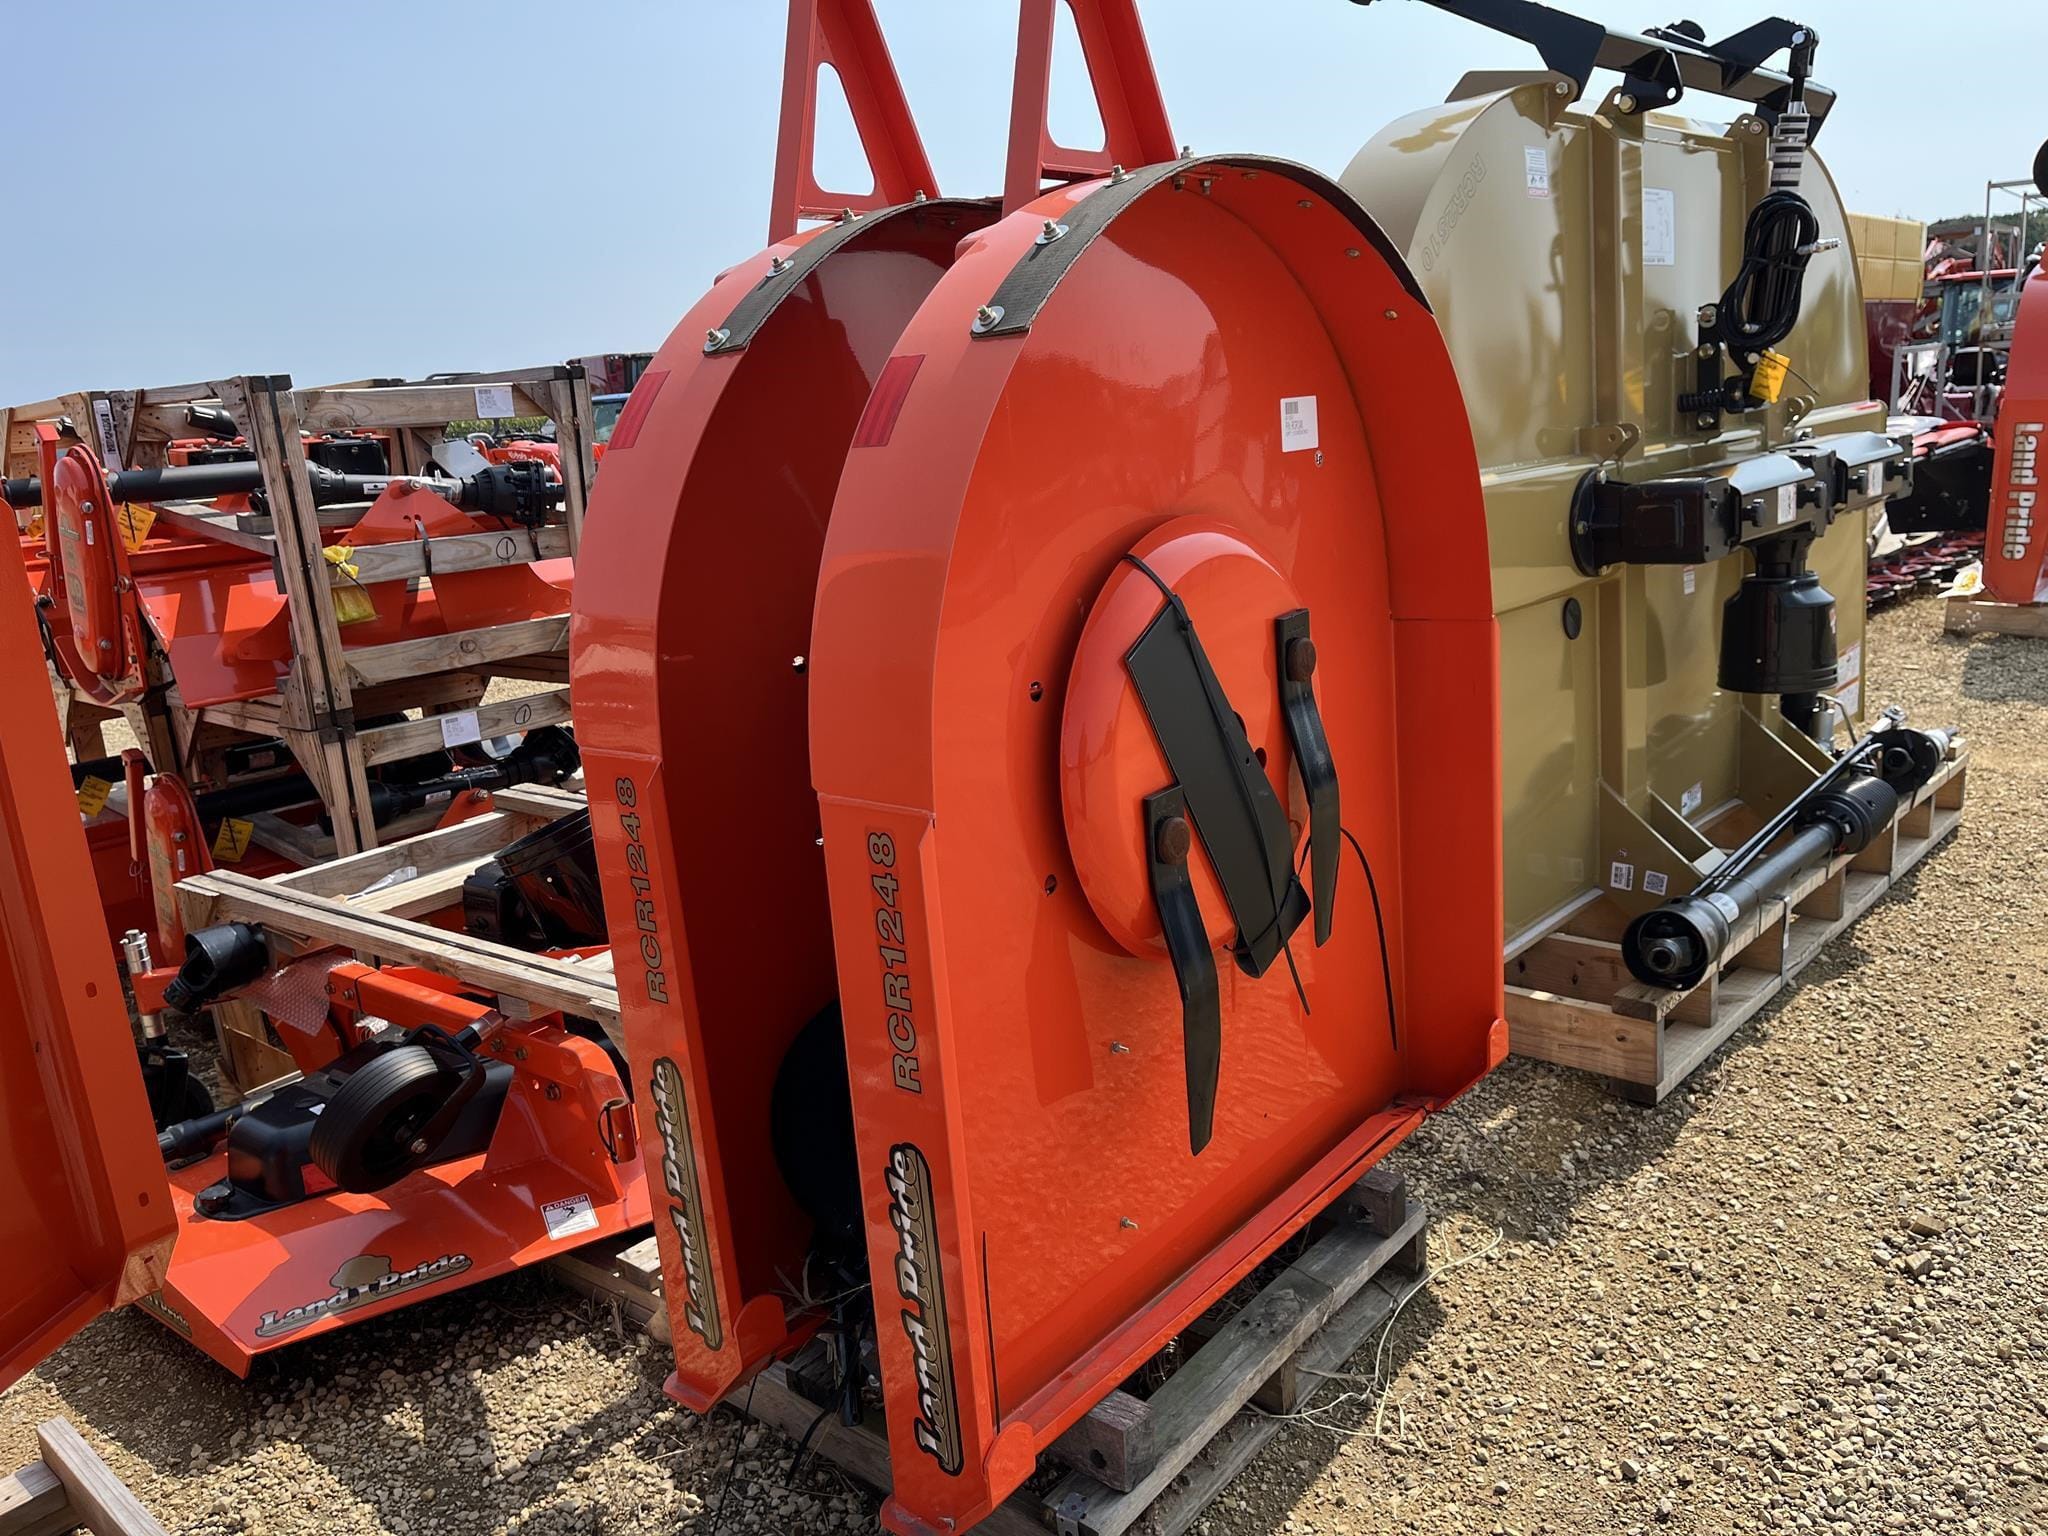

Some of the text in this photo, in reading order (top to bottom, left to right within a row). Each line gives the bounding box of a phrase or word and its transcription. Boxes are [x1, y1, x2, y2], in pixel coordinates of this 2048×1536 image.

[1419, 152, 1488, 272] RCR2510
[2000, 421, 2046, 561] Land Pride
[616, 777, 669, 1004] RCR1248
[867, 832, 922, 1095] RCR1248
[553, 1195, 587, 1209] DANGER
[654, 1061, 713, 1335] Land Pride
[260, 1253, 469, 1332] Land Pride
[889, 1149, 951, 1466] Land Pride
